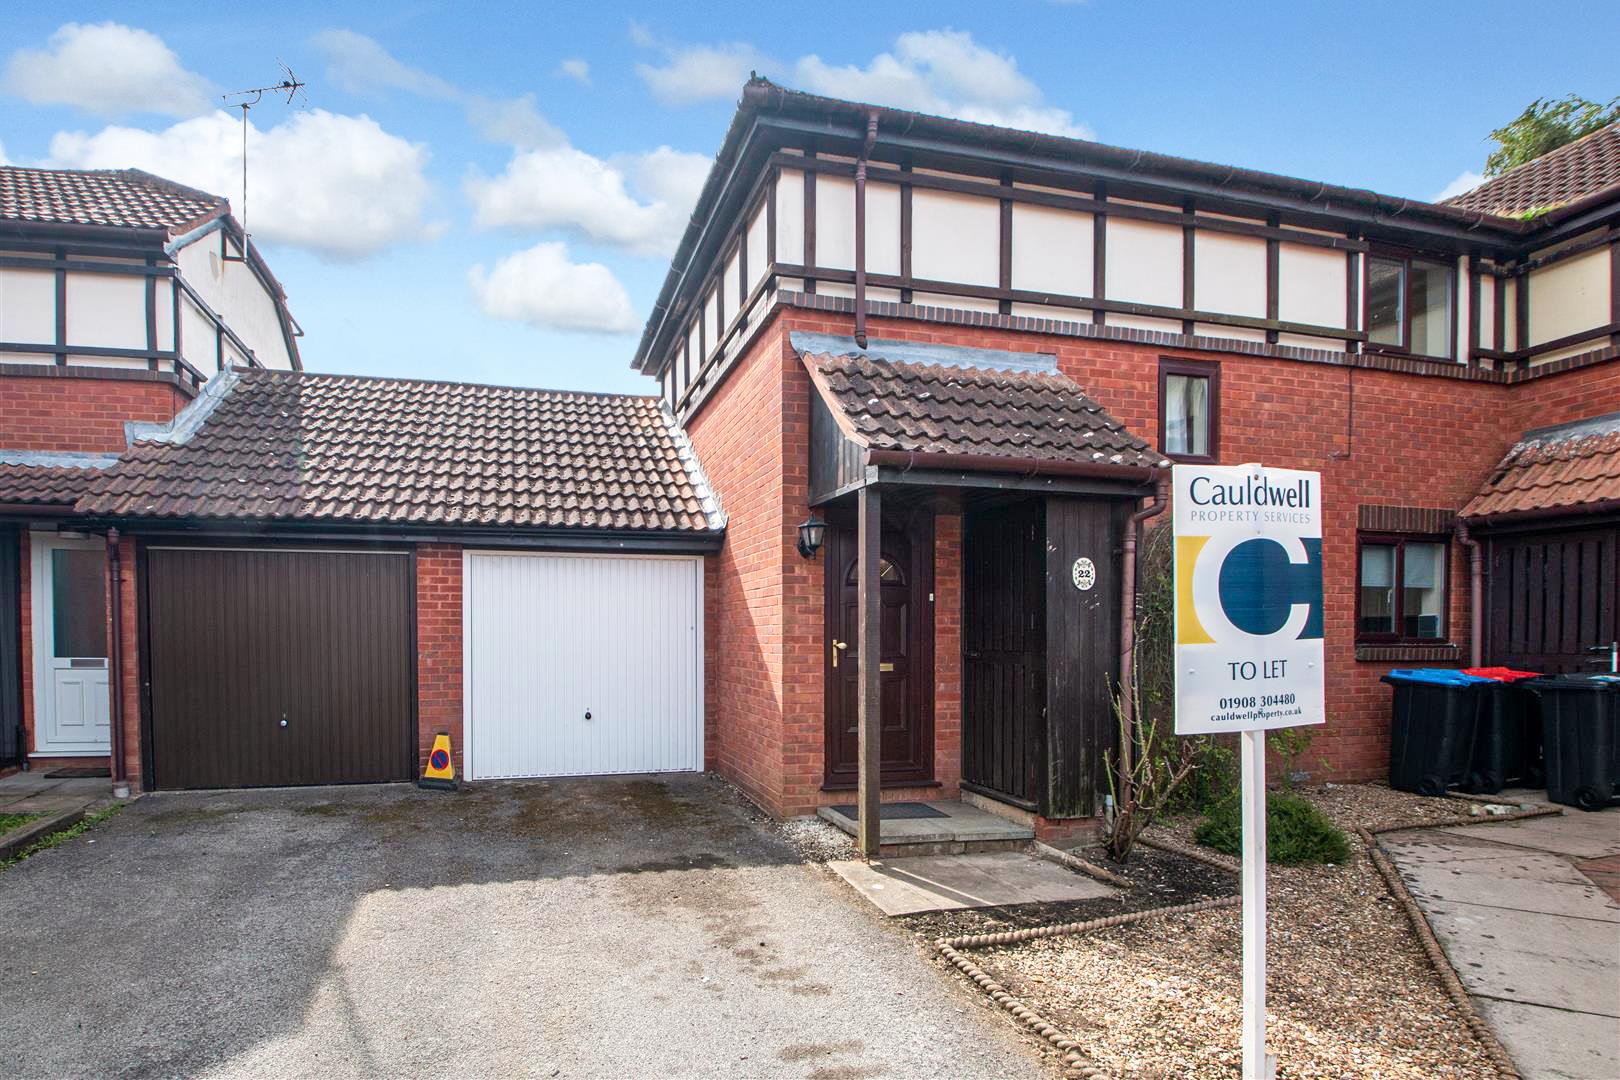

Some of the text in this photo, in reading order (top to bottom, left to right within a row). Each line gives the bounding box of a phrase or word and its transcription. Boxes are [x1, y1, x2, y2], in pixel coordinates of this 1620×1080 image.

[1190, 475, 1310, 508] Cauldwell
[1190, 510, 1311, 524] PROPERTY SERVICES
[1078, 569, 1091, 578] 22
[1227, 659, 1288, 681] TO LET
[1219, 693, 1296, 710] 01908 304480
[1210, 706, 1302, 722] cauldwellproperty.co.uk
